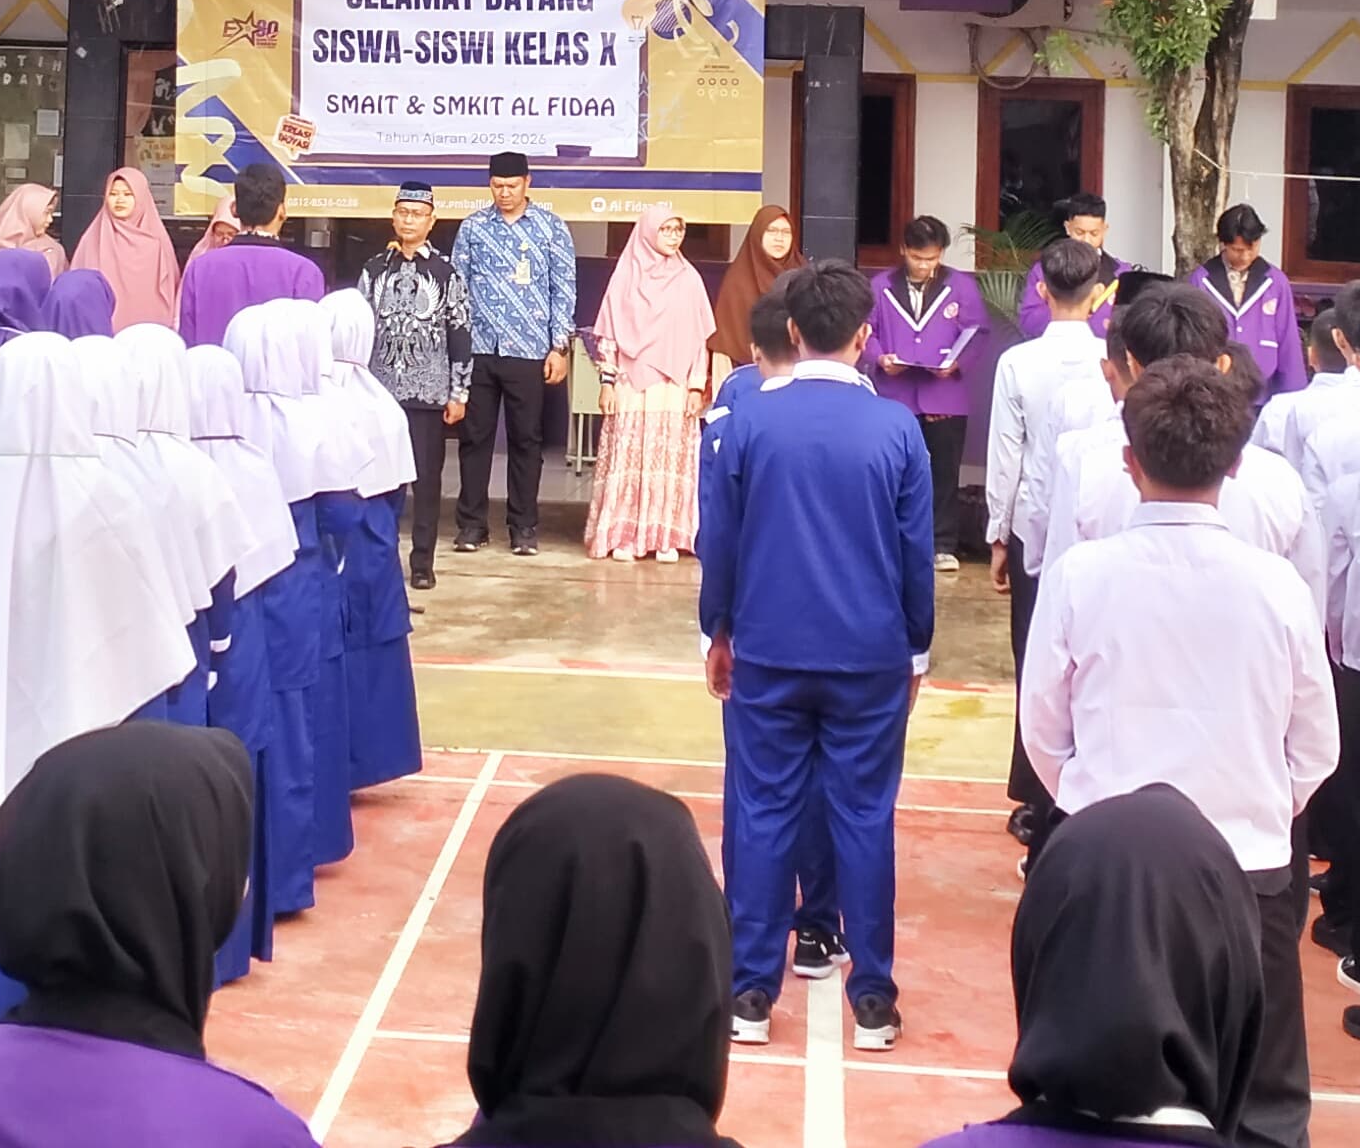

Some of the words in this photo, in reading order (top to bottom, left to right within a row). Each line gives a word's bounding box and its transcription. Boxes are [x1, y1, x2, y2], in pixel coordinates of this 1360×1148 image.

[313, 28, 494, 65] SISWA-SISWI
[505, 31, 589, 65] KELAS
[599, 32, 617, 66] X
[2, 72, 44, 86] DAY
[326, 94, 399, 114] SMAIT
[406, 95, 426, 114] &
[432, 95, 504, 116] SMKIT
[511, 97, 539, 116] AL
[548, 97, 616, 117] FIDAA
[376, 131, 420, 143] Tahun
[423, 132, 468, 146] Ajaran
[610, 199, 621, 212] Al
